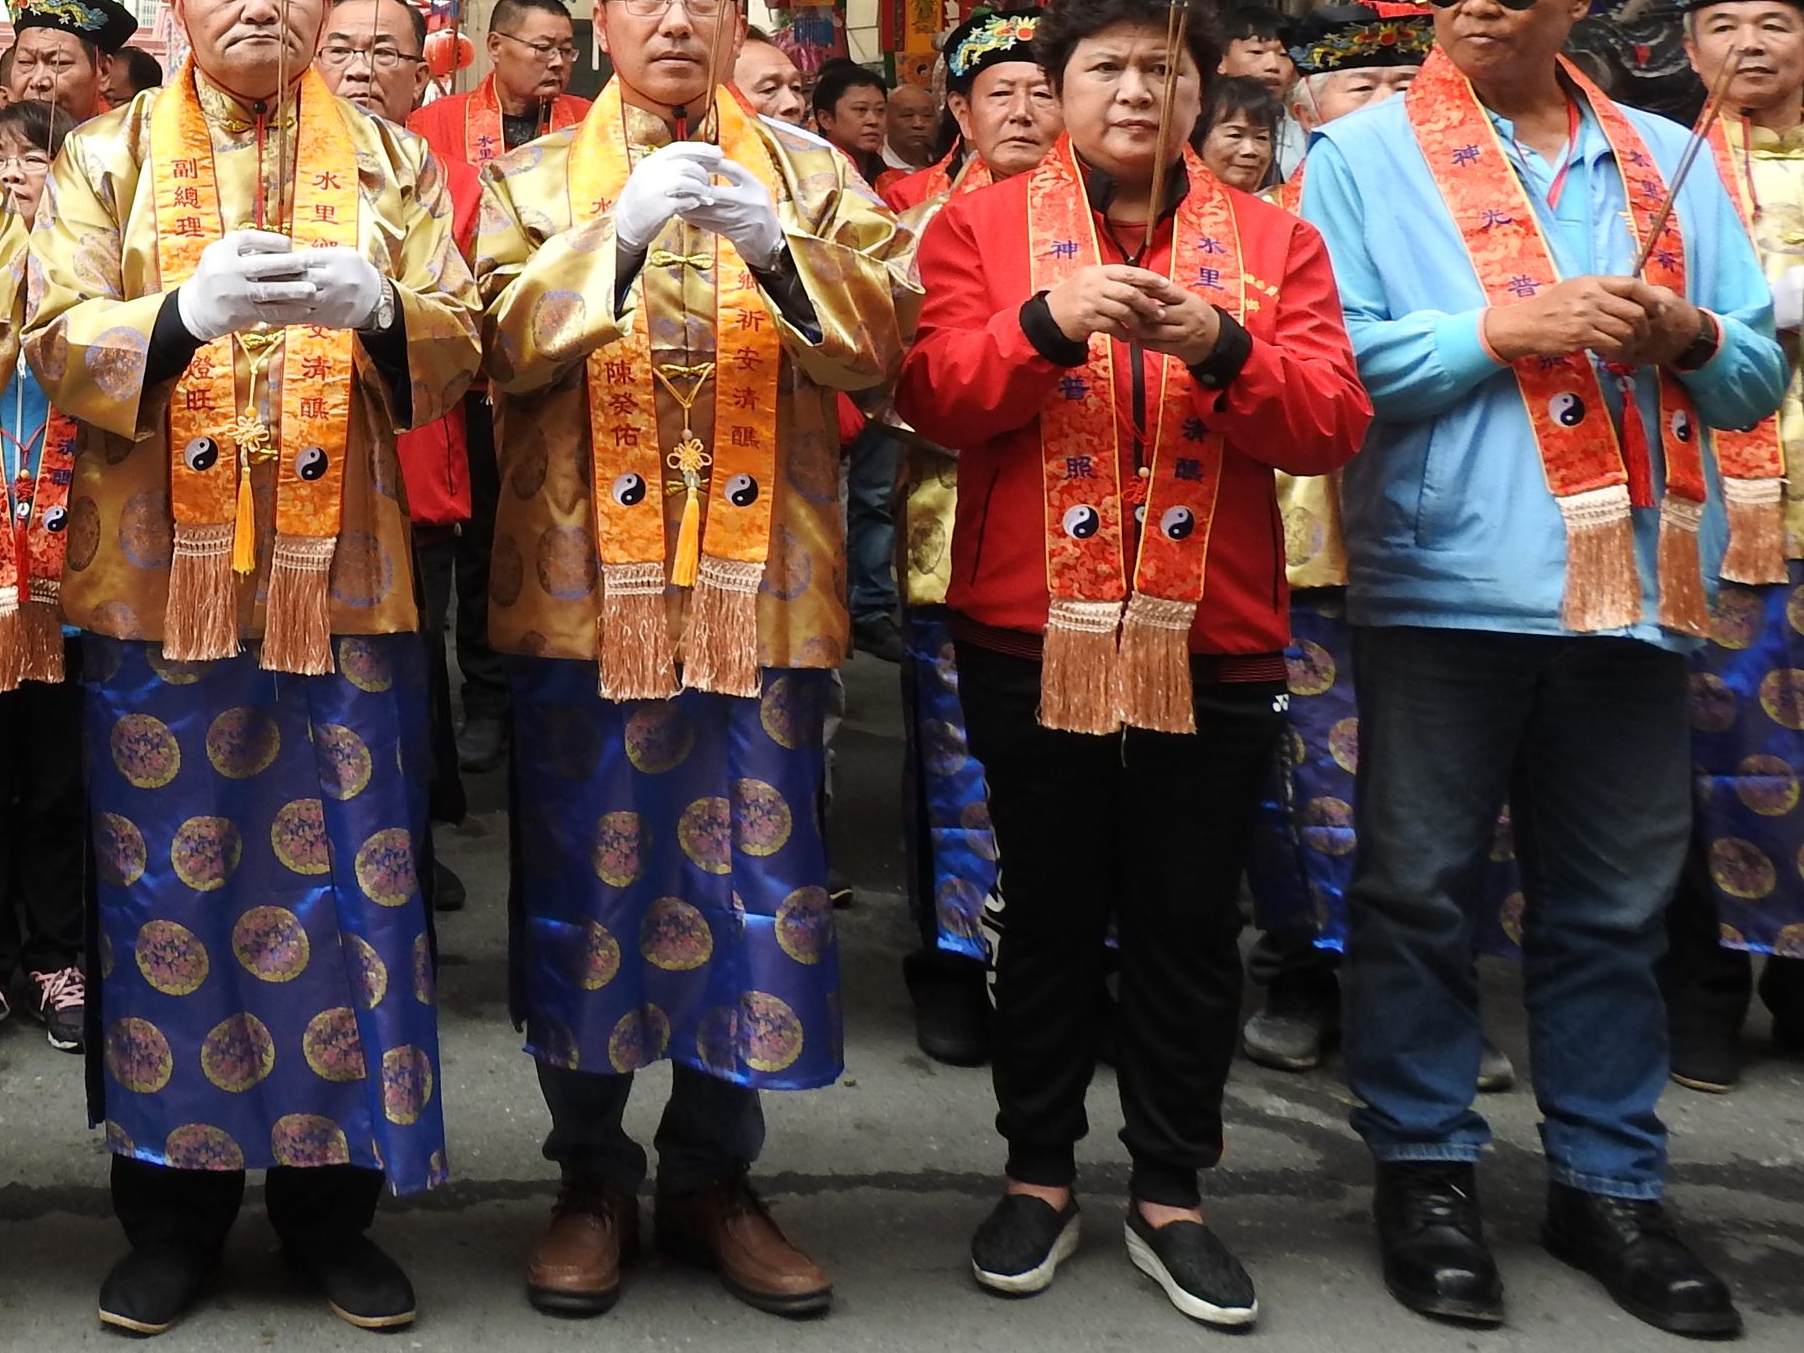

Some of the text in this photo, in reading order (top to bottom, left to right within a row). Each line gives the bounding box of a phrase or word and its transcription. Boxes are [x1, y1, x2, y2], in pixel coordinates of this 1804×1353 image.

[171, 158, 205, 238] 副總理
[1193, 237, 1227, 291] 水里
[1051, 239, 1097, 480] 神 普照
[604, 360, 643, 448] 陳癸佑
